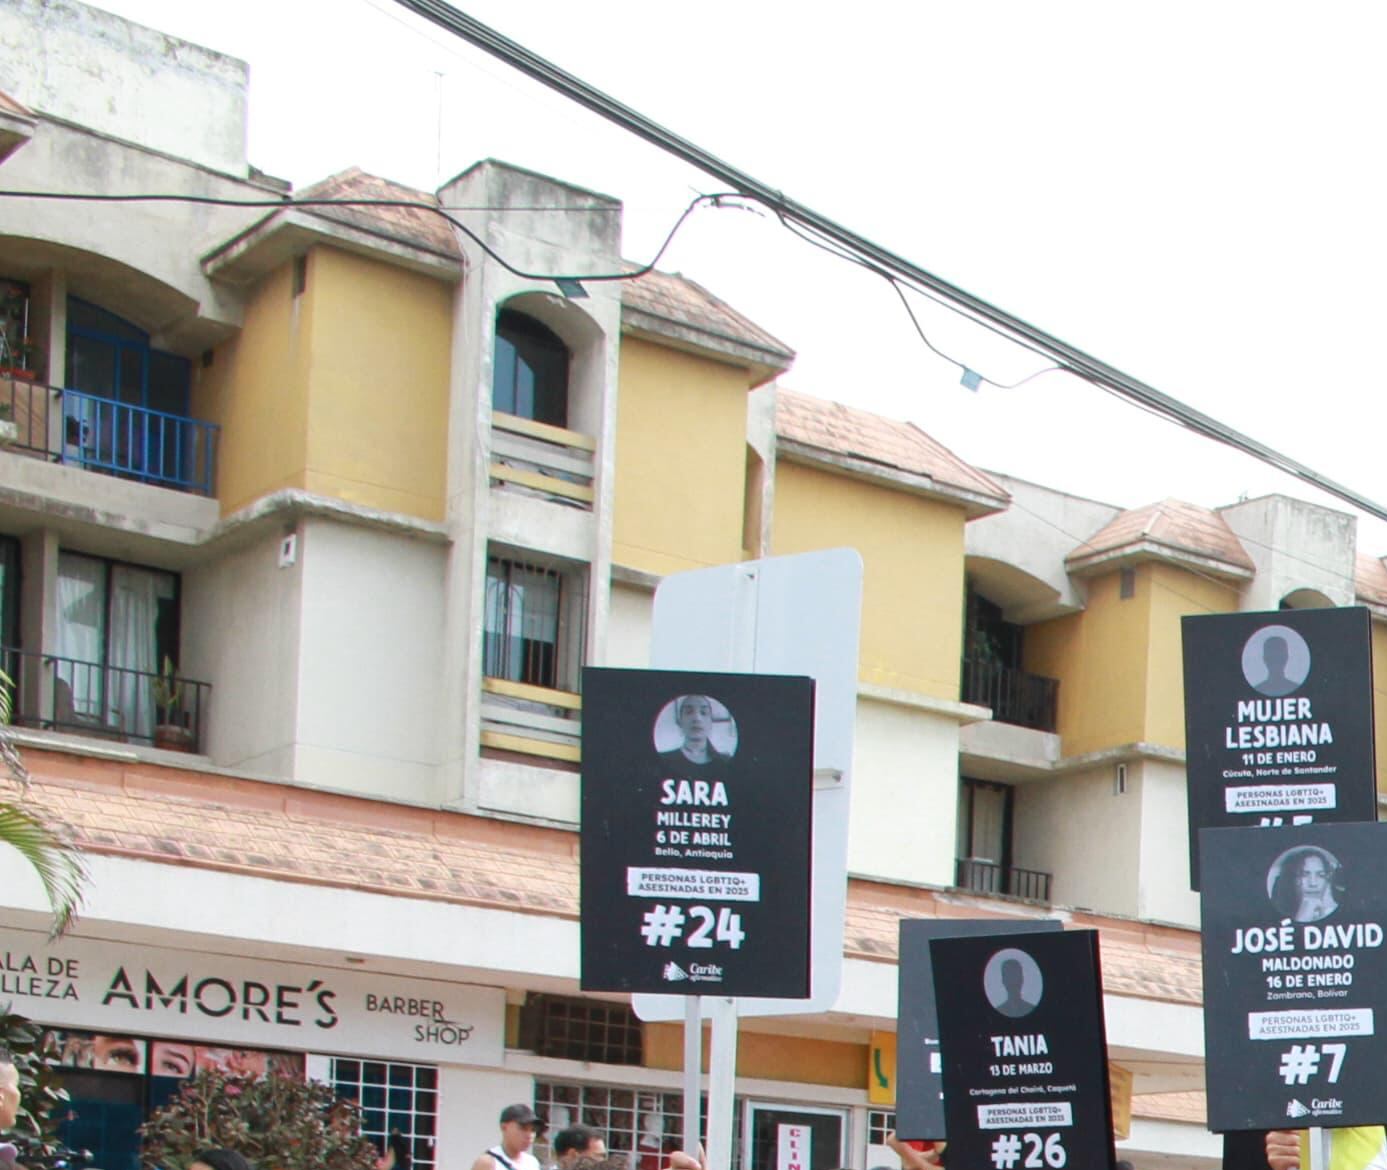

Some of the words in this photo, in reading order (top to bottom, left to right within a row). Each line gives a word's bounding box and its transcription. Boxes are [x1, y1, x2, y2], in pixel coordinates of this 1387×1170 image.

[1238, 698, 1312, 723] MUJER
[1226, 723, 1333, 749] LESBIANA
[1242, 755, 1254, 765] 11
[1258, 753, 1272, 764] DE
[1277, 751, 1316, 763] ENERO
[1257, 768, 1279, 777] Norte
[1282, 767, 1292, 775] de
[660, 779, 729, 807] SARA
[657, 811, 731, 828] MILLEREY
[656, 832, 666, 844] 6
[670, 833, 689, 845] DE
[693, 833, 732, 846] ABRIL
[685, 849, 733, 859] Antioquia
[641, 873, 696, 883] PERSONAS
[638, 884, 705, 894] ASESINADAS
[708, 886, 722, 894] EN
[725, 887, 749, 896] 2025
[641, 904, 745, 949] #24
[1232, 918, 1294, 954] JOSÉ
[1305, 923, 1383, 949] DAVID
[48, 957, 79, 979] DE
[689, 963, 723, 976] Caribe
[1263, 955, 1354, 972] MALDONADO
[1267, 976, 1282, 988] 16
[1286, 975, 1304, 988] DE
[1308, 973, 1352, 986] ENERO
[1267, 990, 1315, 1000] Zambrano,
[366, 994, 444, 1023] BARBER
[1259, 1024, 1321, 1034] ASESINADAS
[1339, 1022, 1360, 1031] 2025
[1262, 1016, 1312, 1025] PERSONAS
[415, 1023, 474, 1045] SHOP
[991, 1034, 1048, 1057] TANIA
[990, 1066, 1000, 1076] 13
[1002, 1064, 1016, 1076] DE
[1019, 1062, 1053, 1074] MARZO
[1279, 1044, 1347, 1085] #7
[1312, 1098, 1343, 1110] Caribe
[991, 1132, 1066, 1170] #26
